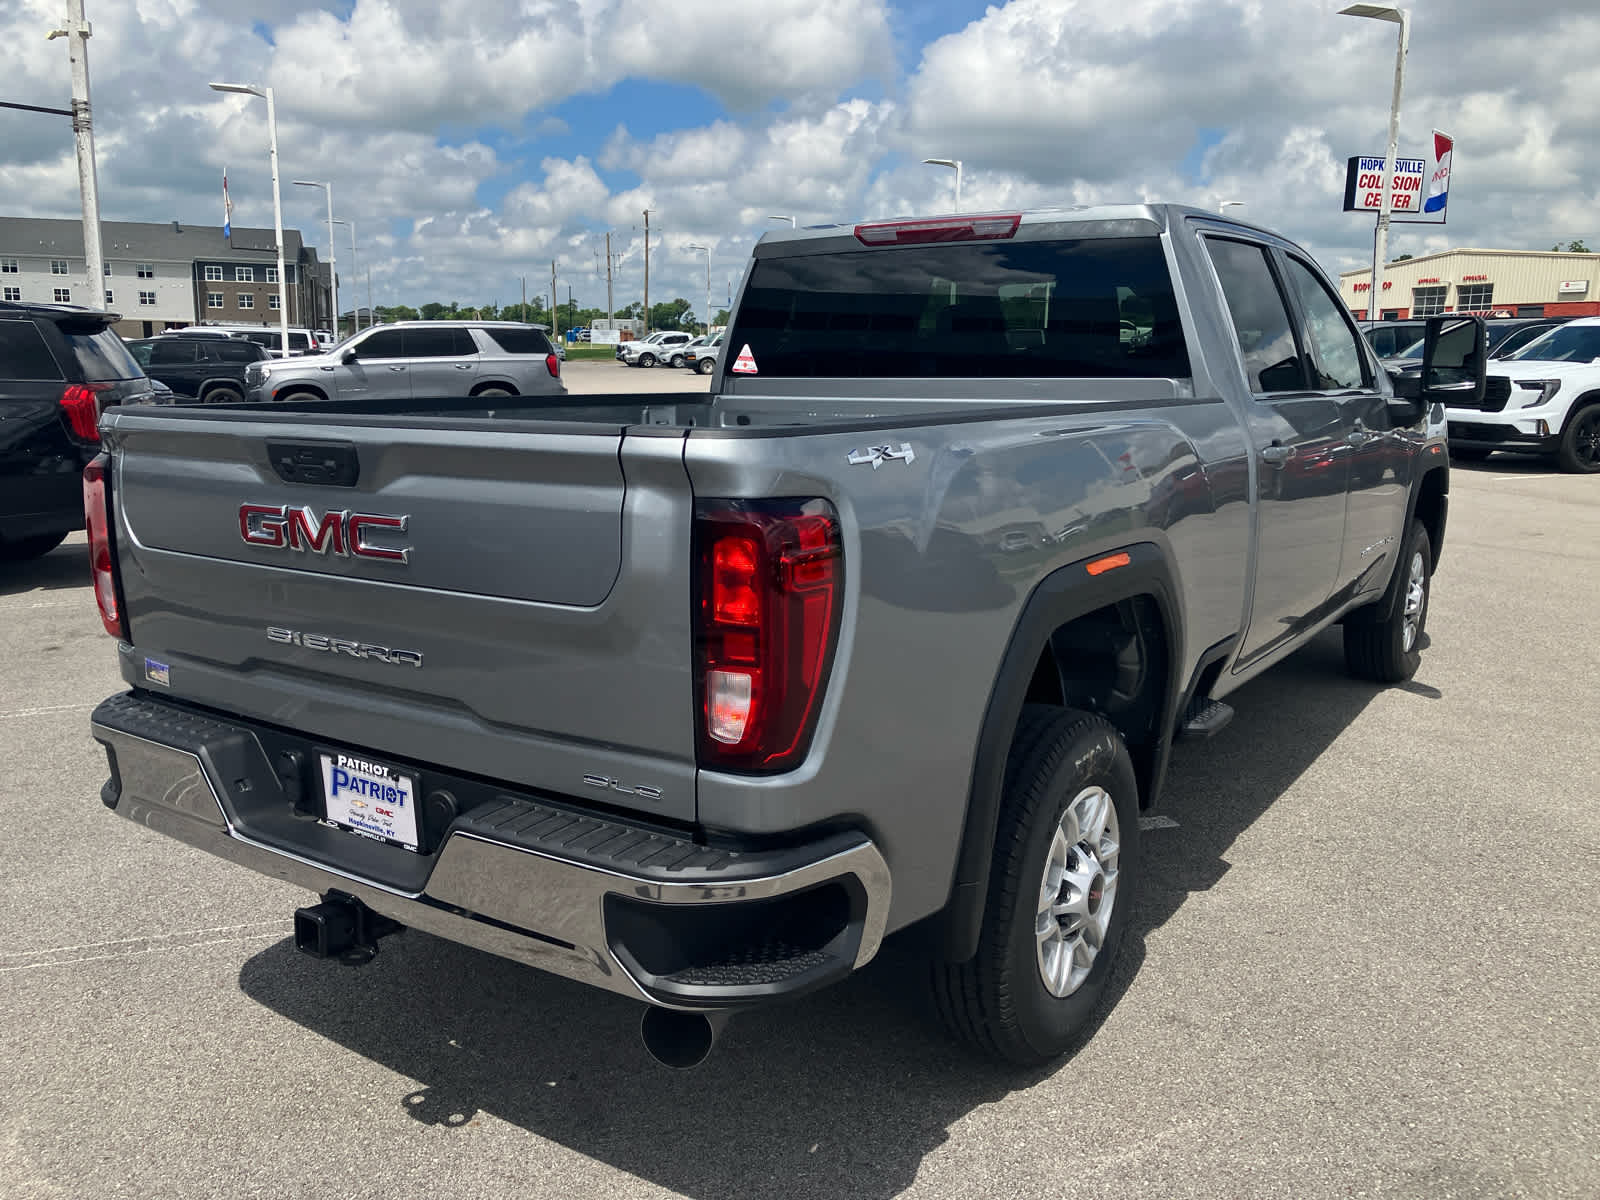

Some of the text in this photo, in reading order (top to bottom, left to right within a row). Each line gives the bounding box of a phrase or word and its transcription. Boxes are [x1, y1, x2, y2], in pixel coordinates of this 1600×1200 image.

[1360, 159, 1423, 173] HOPKSVILLE
[1359, 174, 1421, 191] COLSION
[1365, 192, 1411, 208] CETER
[239, 503, 412, 564] GMC
[266, 626, 424, 668] SIERRA
[337, 754, 389, 777] PATRIOT
[331, 766, 408, 807] PATRIOT
[375, 806, 394, 818] GMC
[386, 829, 395, 837] KY
